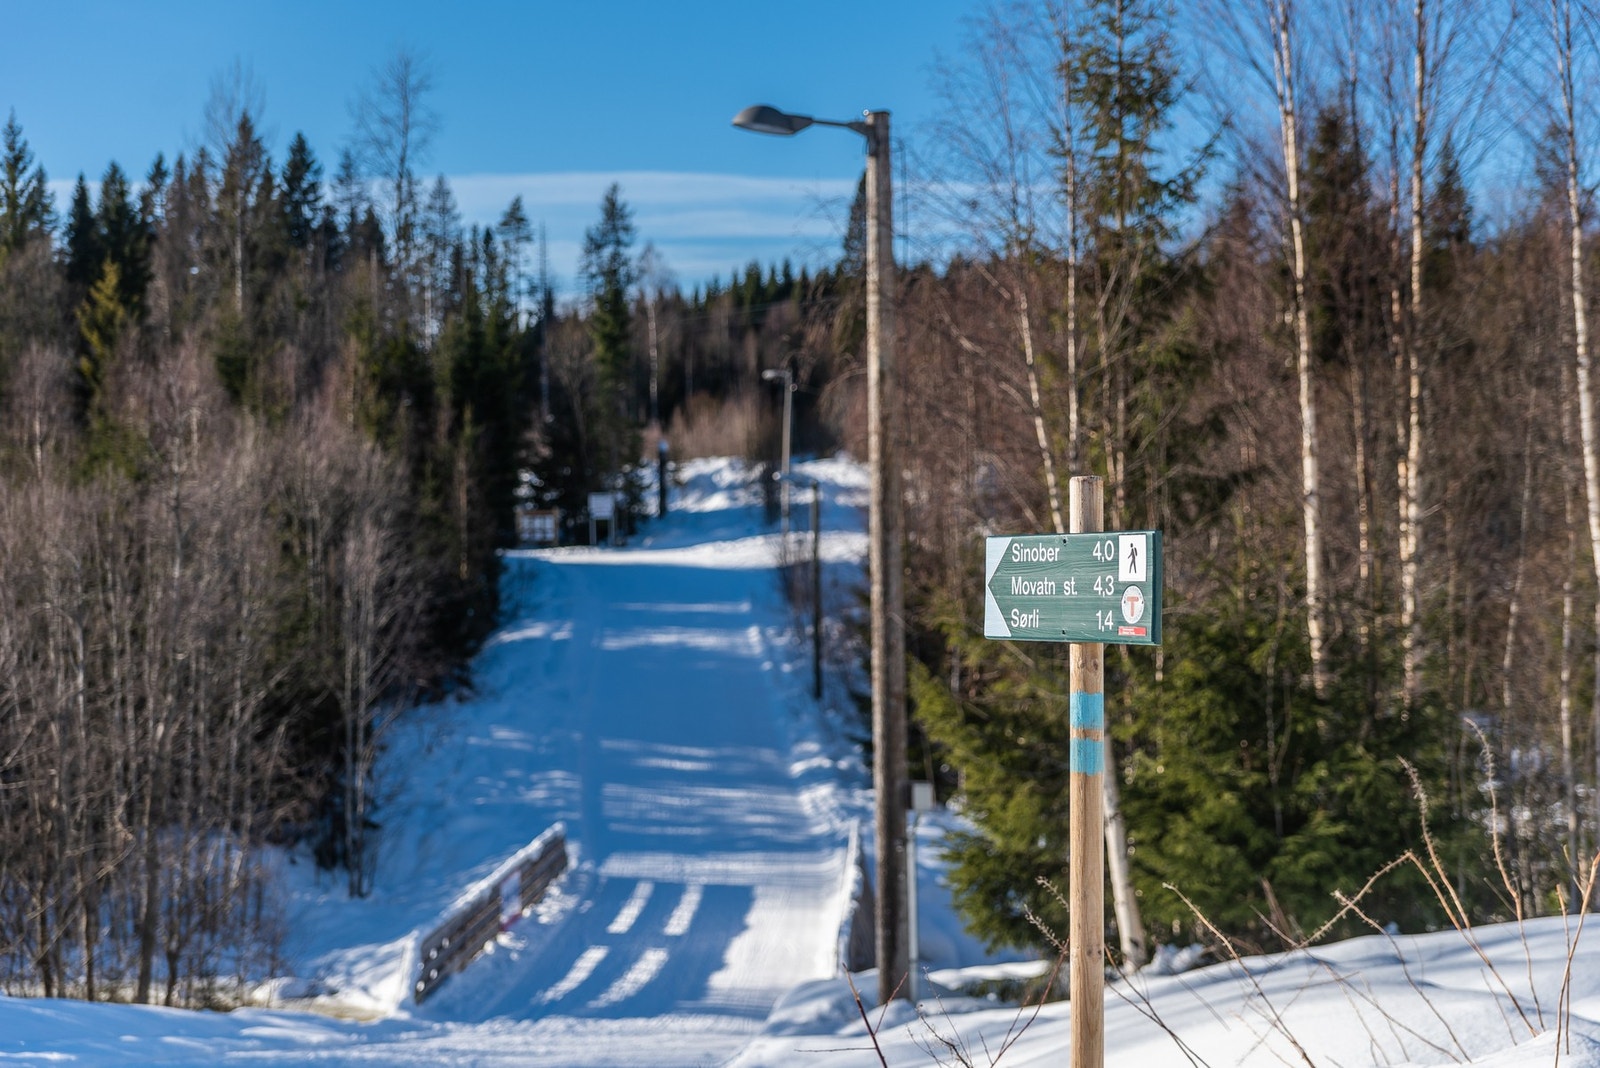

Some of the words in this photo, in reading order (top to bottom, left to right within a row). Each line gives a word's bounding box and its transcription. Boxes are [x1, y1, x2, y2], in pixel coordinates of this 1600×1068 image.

[1011, 543, 1060, 562] Sinober
[1092, 540, 1115, 562] 4,0
[1011, 576, 1056, 595] Movatn
[1063, 576, 1078, 595] st.
[1093, 575, 1115, 597] 4,3
[1010, 608, 1039, 628] Sørli
[1095, 609, 1114, 632] 1,4
